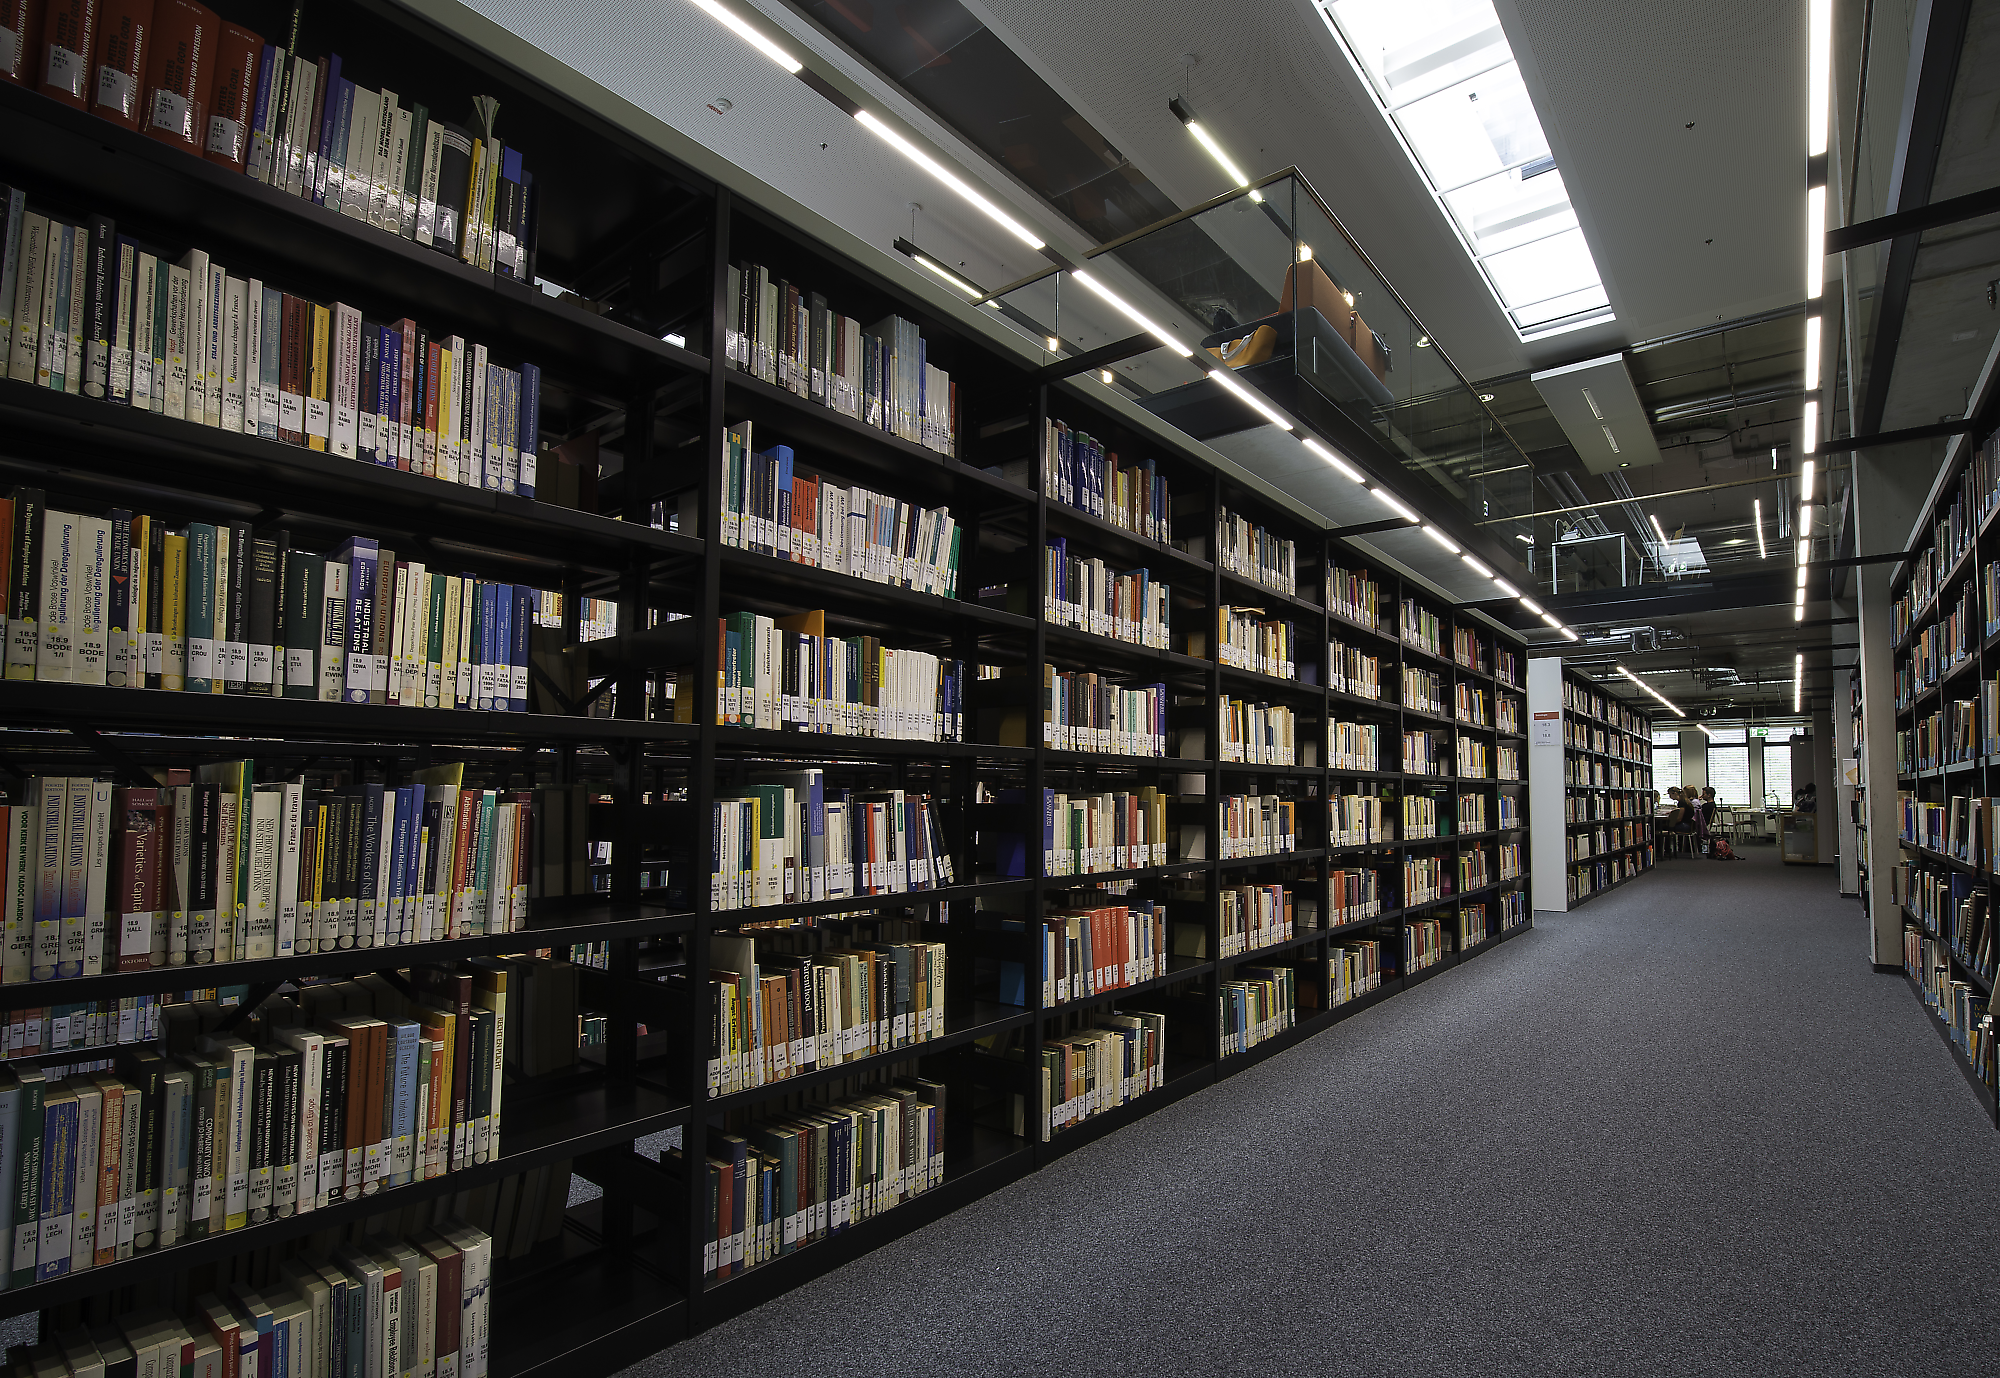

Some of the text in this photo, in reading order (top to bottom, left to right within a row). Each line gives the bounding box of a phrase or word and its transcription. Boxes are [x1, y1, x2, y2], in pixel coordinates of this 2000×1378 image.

[61, 523, 71, 573] Deregulierung
[95, 529, 105, 577] Deregulierung
[60, 573, 68, 586] der
[381, 560, 389, 607] EUROPEAN
[353, 599, 362, 652] RELATIONS
[361, 598, 371, 653] INDUSTRIAL
[47, 643, 72, 651] BODE
[45, 794, 59, 868] INDUSTRIAL RELATIONS
[71, 793, 85, 867] INDUSTRIAL RELATIONS
[290, 814, 297, 822] du
[367, 815, 377, 832] The
[462, 796, 471, 829] Arbitration
[20, 845, 26, 853] EN
[134, 832, 148, 874] Varieties
[365, 833, 376, 869] Workers
[363, 871, 373, 881] of
[804, 959, 812, 1011] Parenthood
